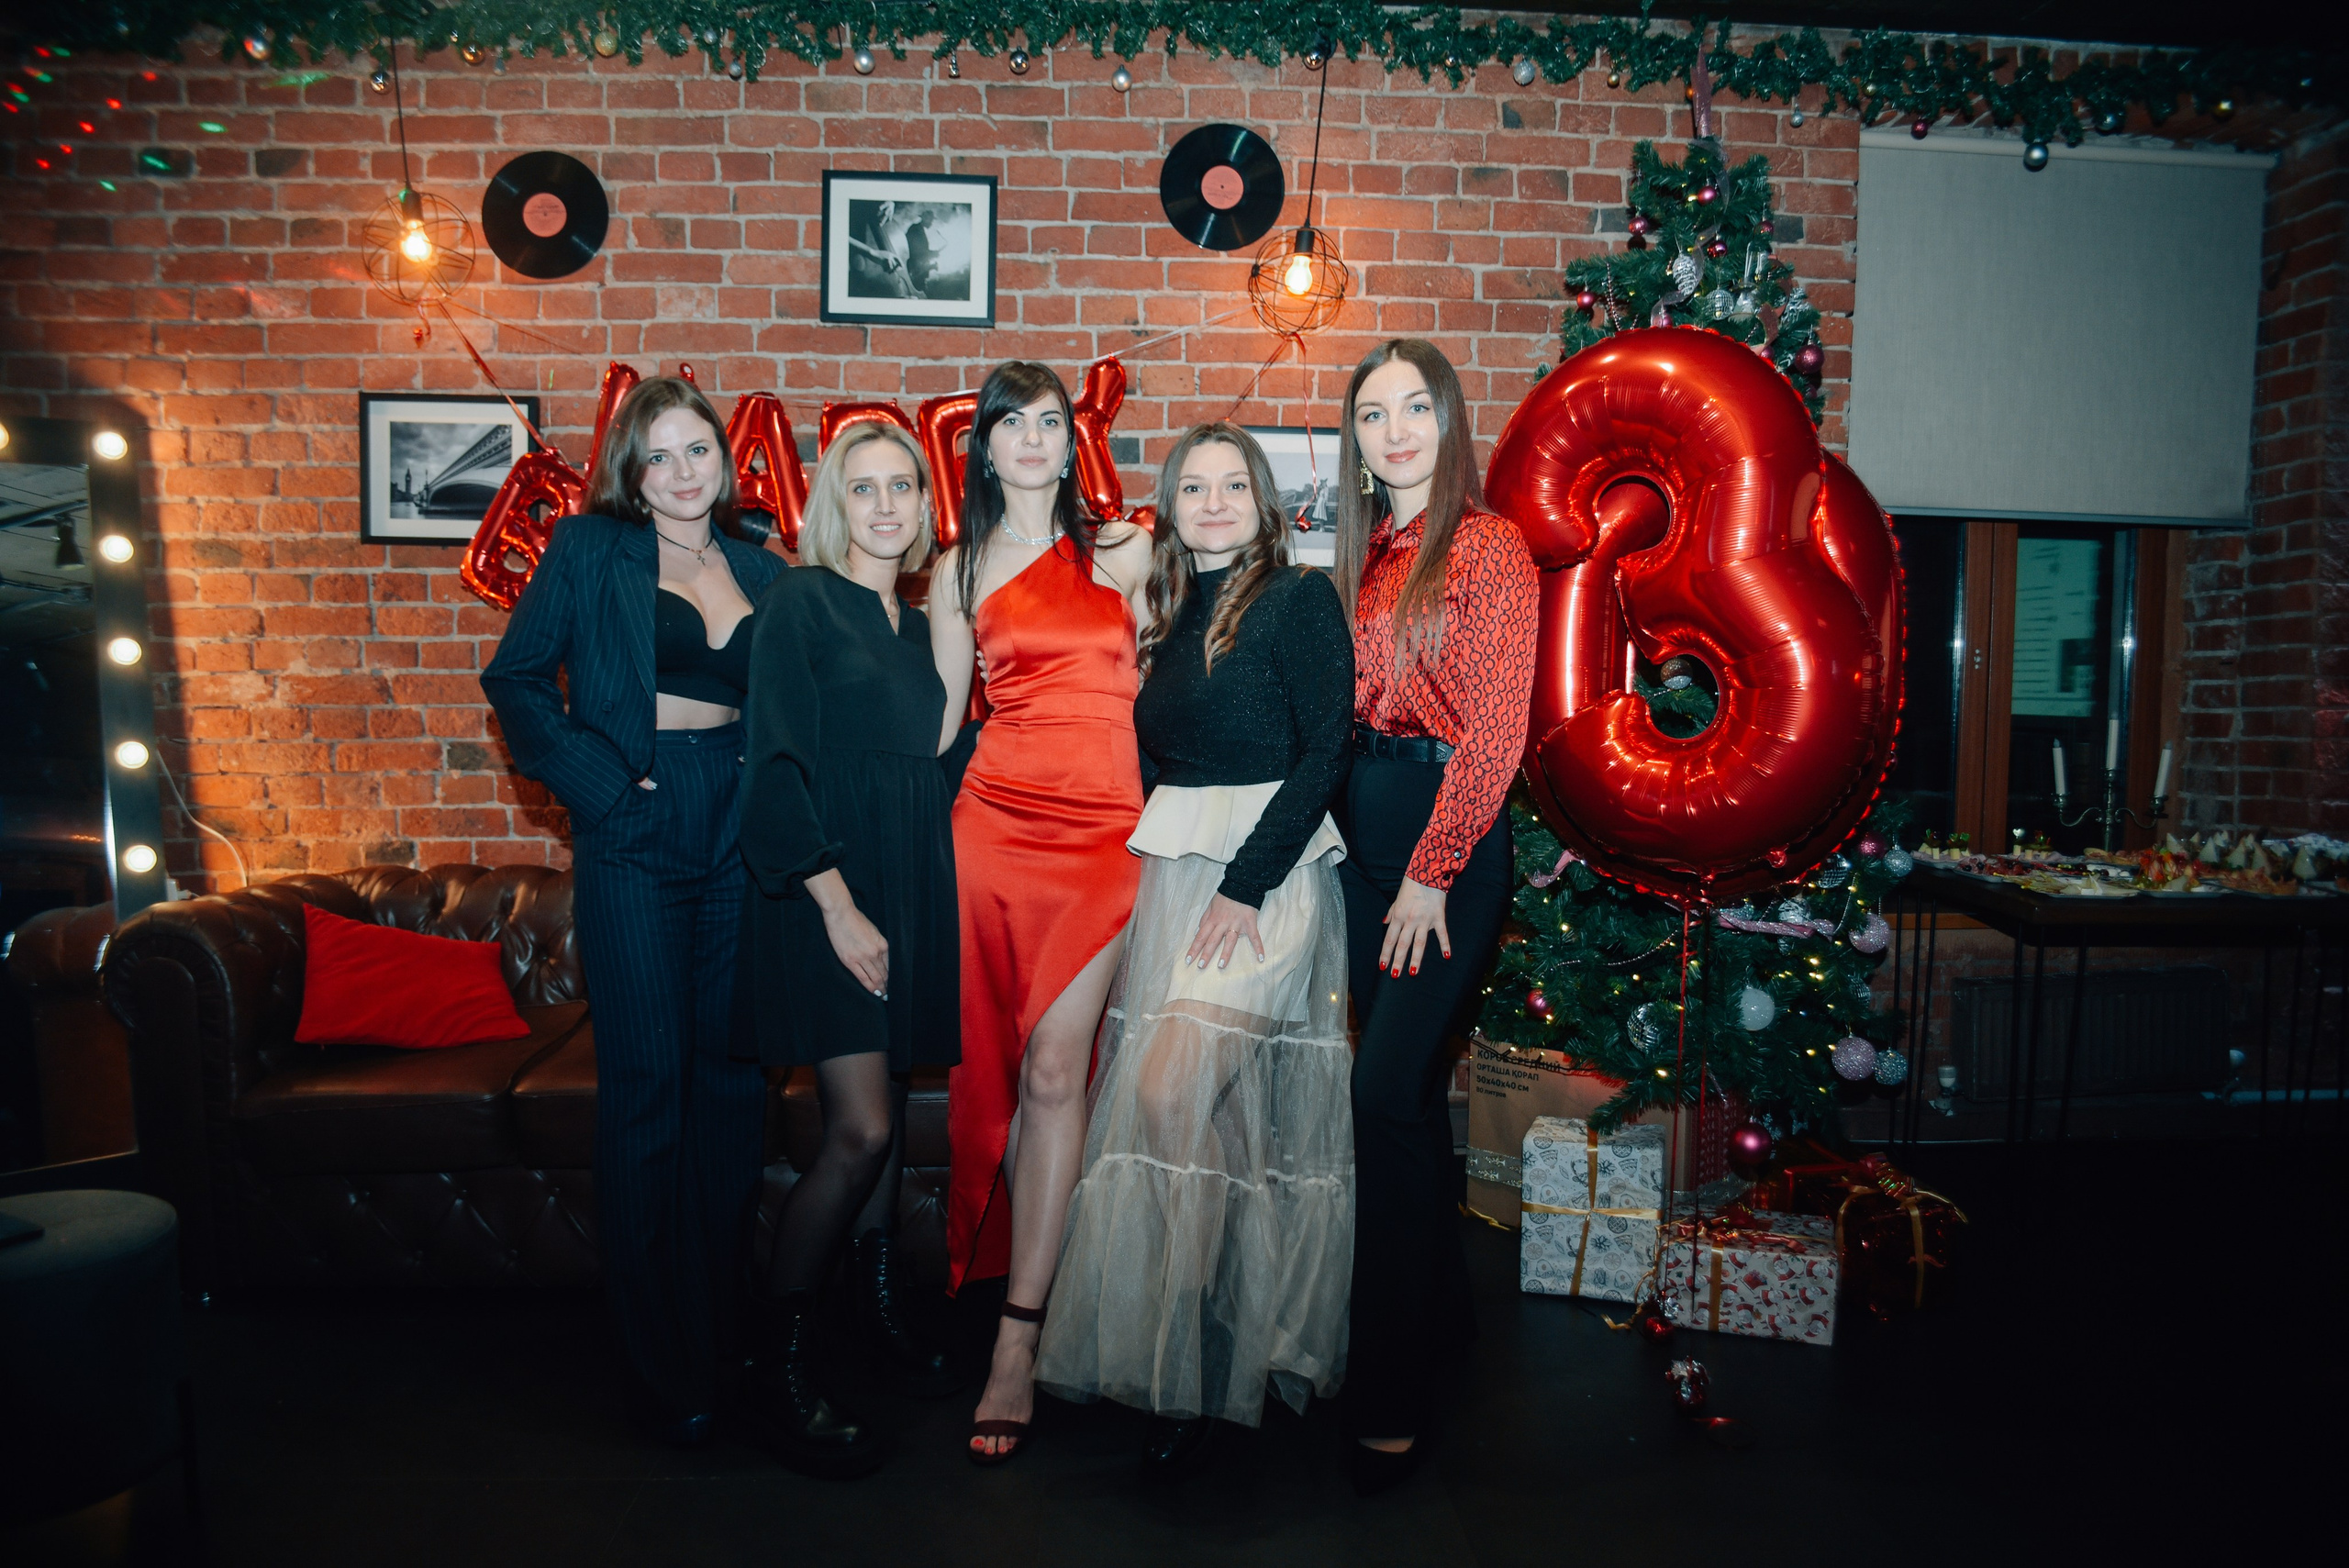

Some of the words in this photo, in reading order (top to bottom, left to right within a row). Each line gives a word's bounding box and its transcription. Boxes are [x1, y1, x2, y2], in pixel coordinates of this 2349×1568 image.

[1476, 1062, 1510, 1076] ОРТАША
[1511, 1069, 1540, 1081] ҚОРАП
[1484, 1089, 1507, 1098] литров
